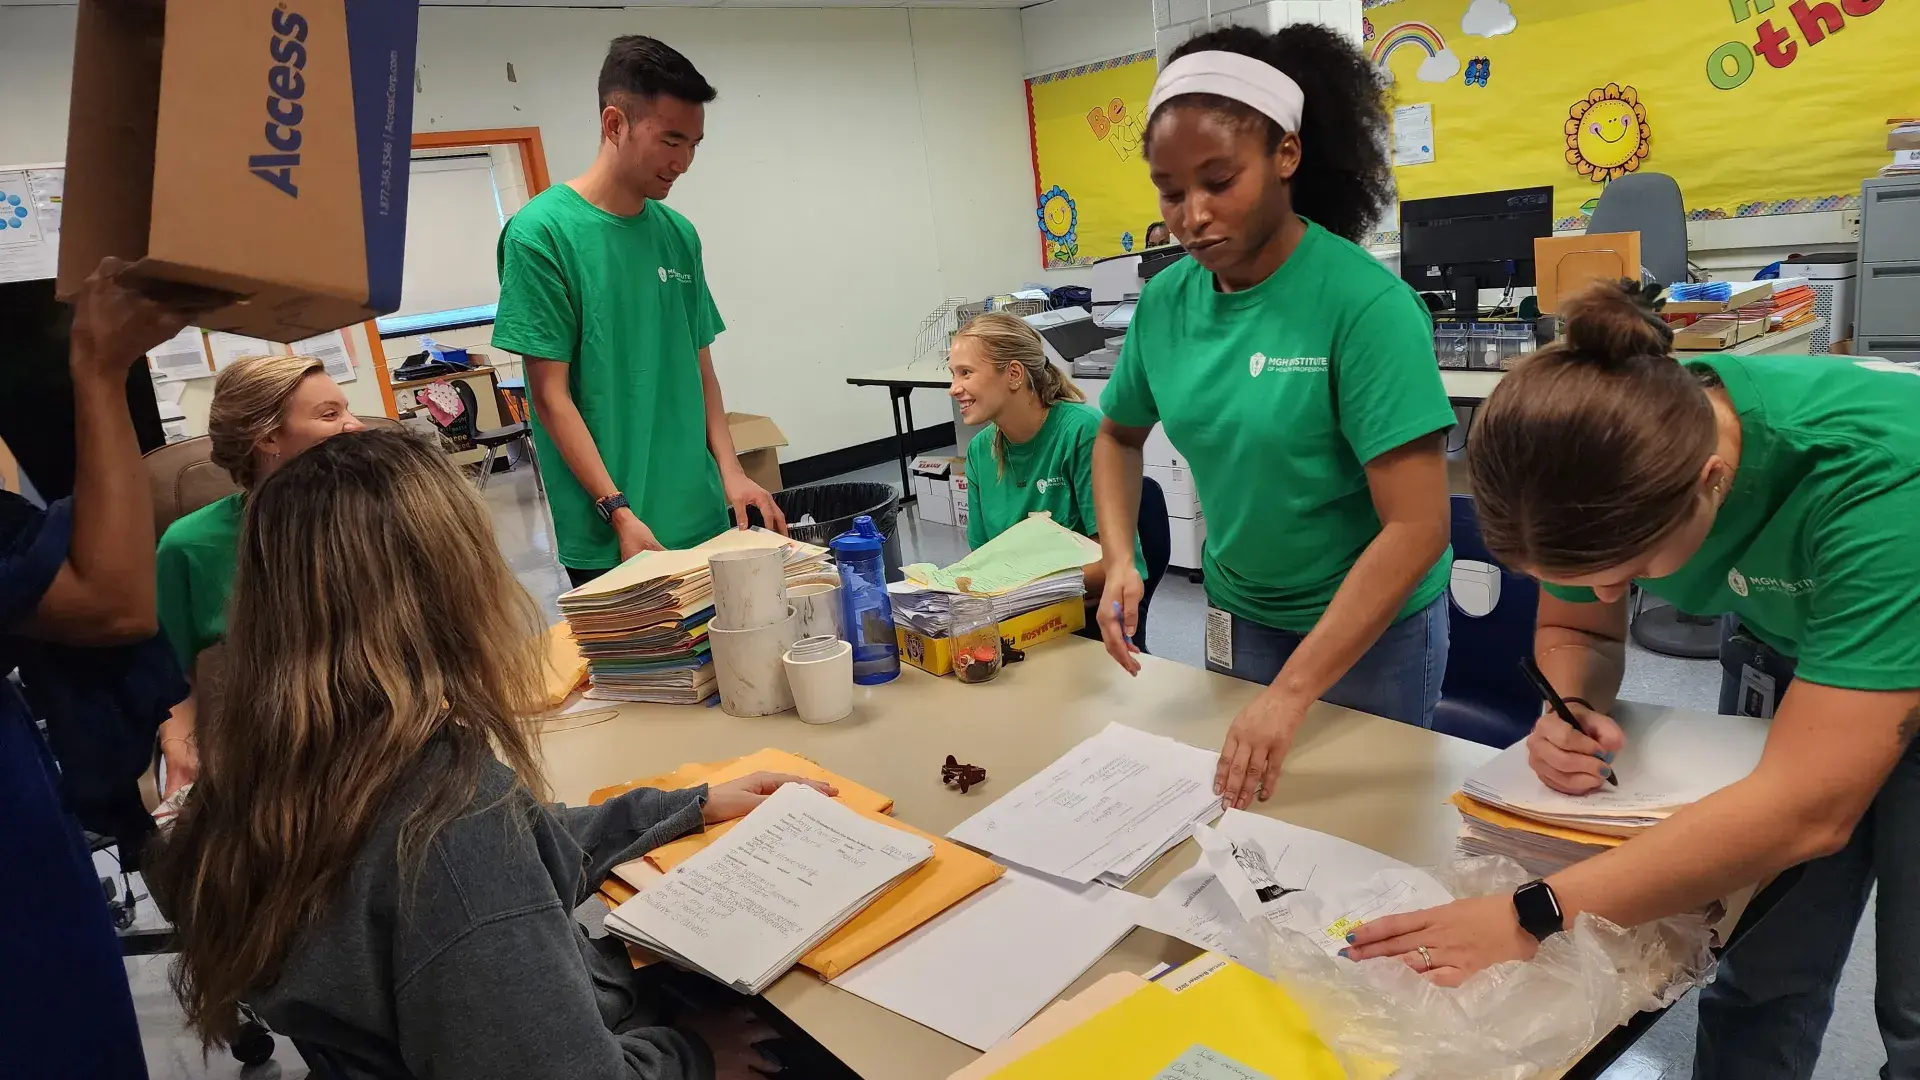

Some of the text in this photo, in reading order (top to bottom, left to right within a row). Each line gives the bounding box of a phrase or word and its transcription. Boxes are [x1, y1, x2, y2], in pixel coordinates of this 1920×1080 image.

[248, 8, 308, 199] Access
[1086, 97, 1126, 141] Be
[1268, 357, 1289, 366] MGH
[1749, 576, 1780, 587] MGH
[1174, 981, 1190, 993] 2022
